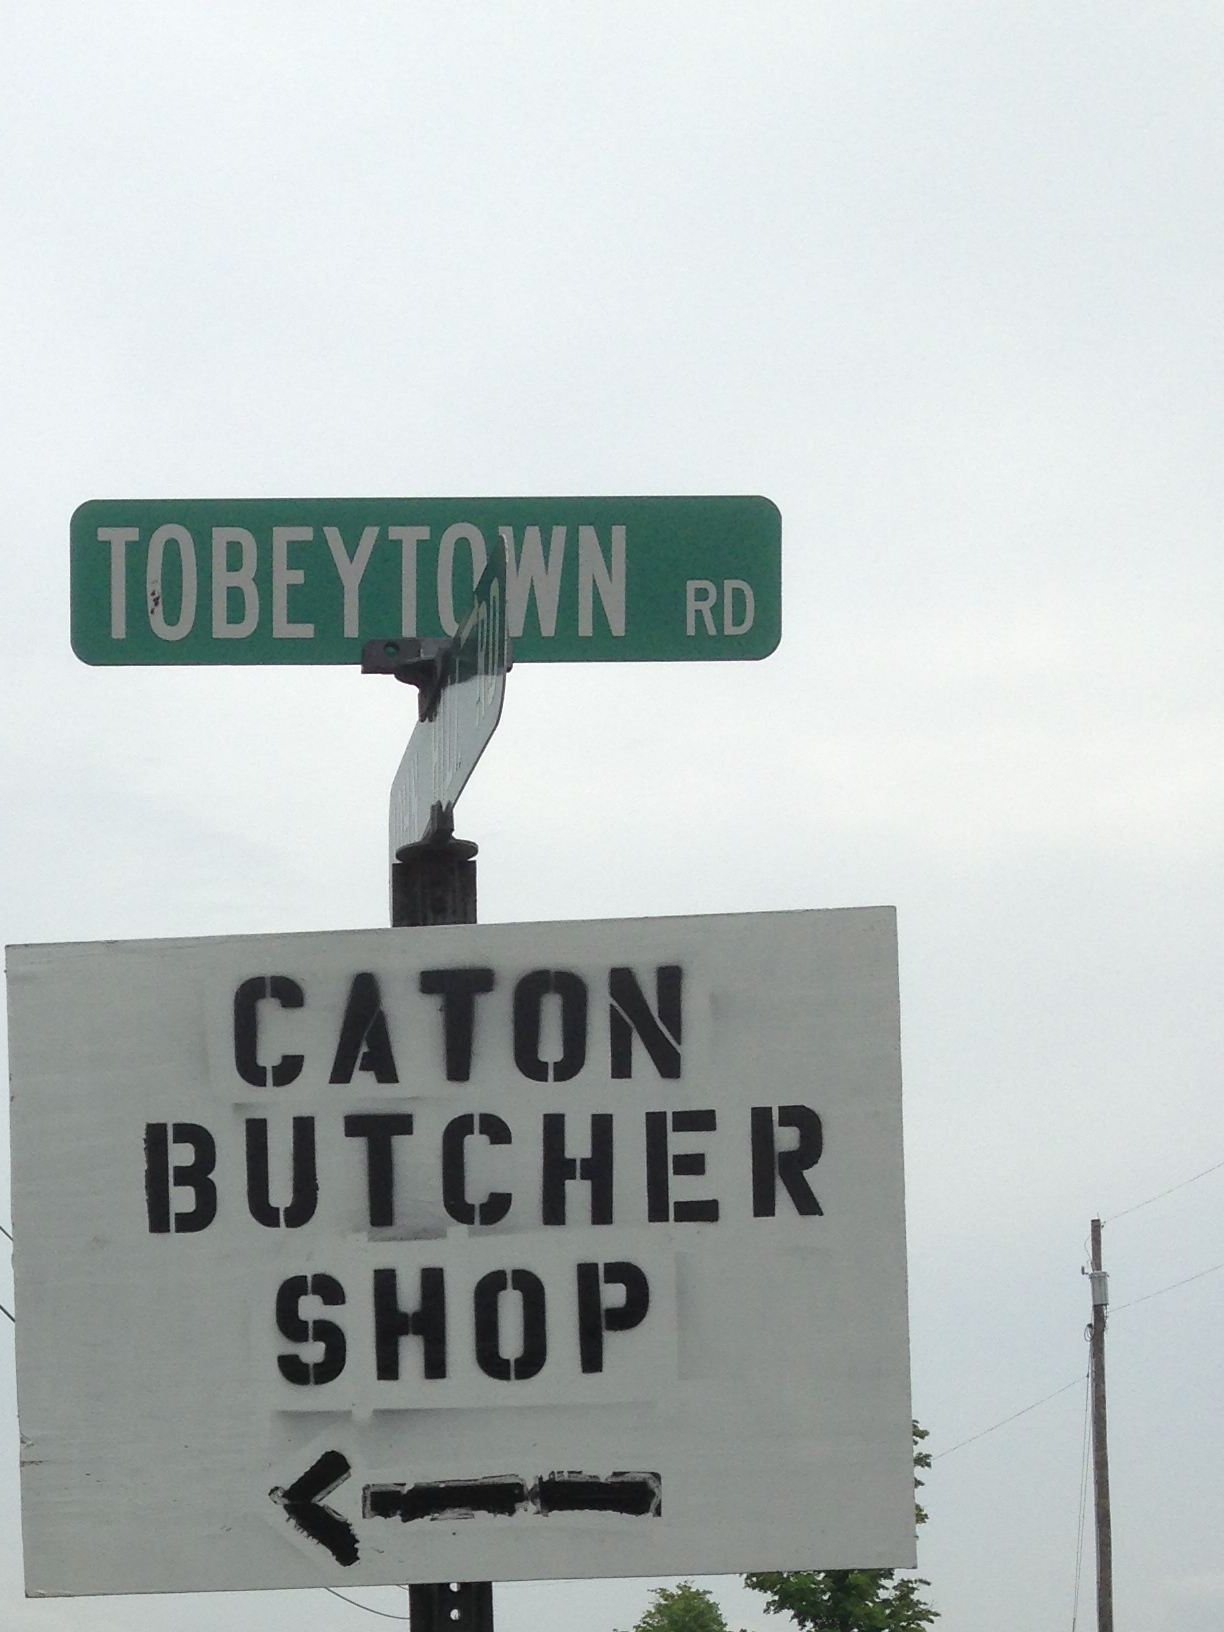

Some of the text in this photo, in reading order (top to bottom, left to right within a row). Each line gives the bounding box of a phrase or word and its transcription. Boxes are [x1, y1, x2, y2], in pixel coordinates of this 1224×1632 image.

[98, 522, 756, 642] TOBEYTOWN RD
[233, 965, 684, 1088] CATON
[144, 1104, 825, 1234] BUTCHER
[275, 1262, 651, 1386] SHOP
